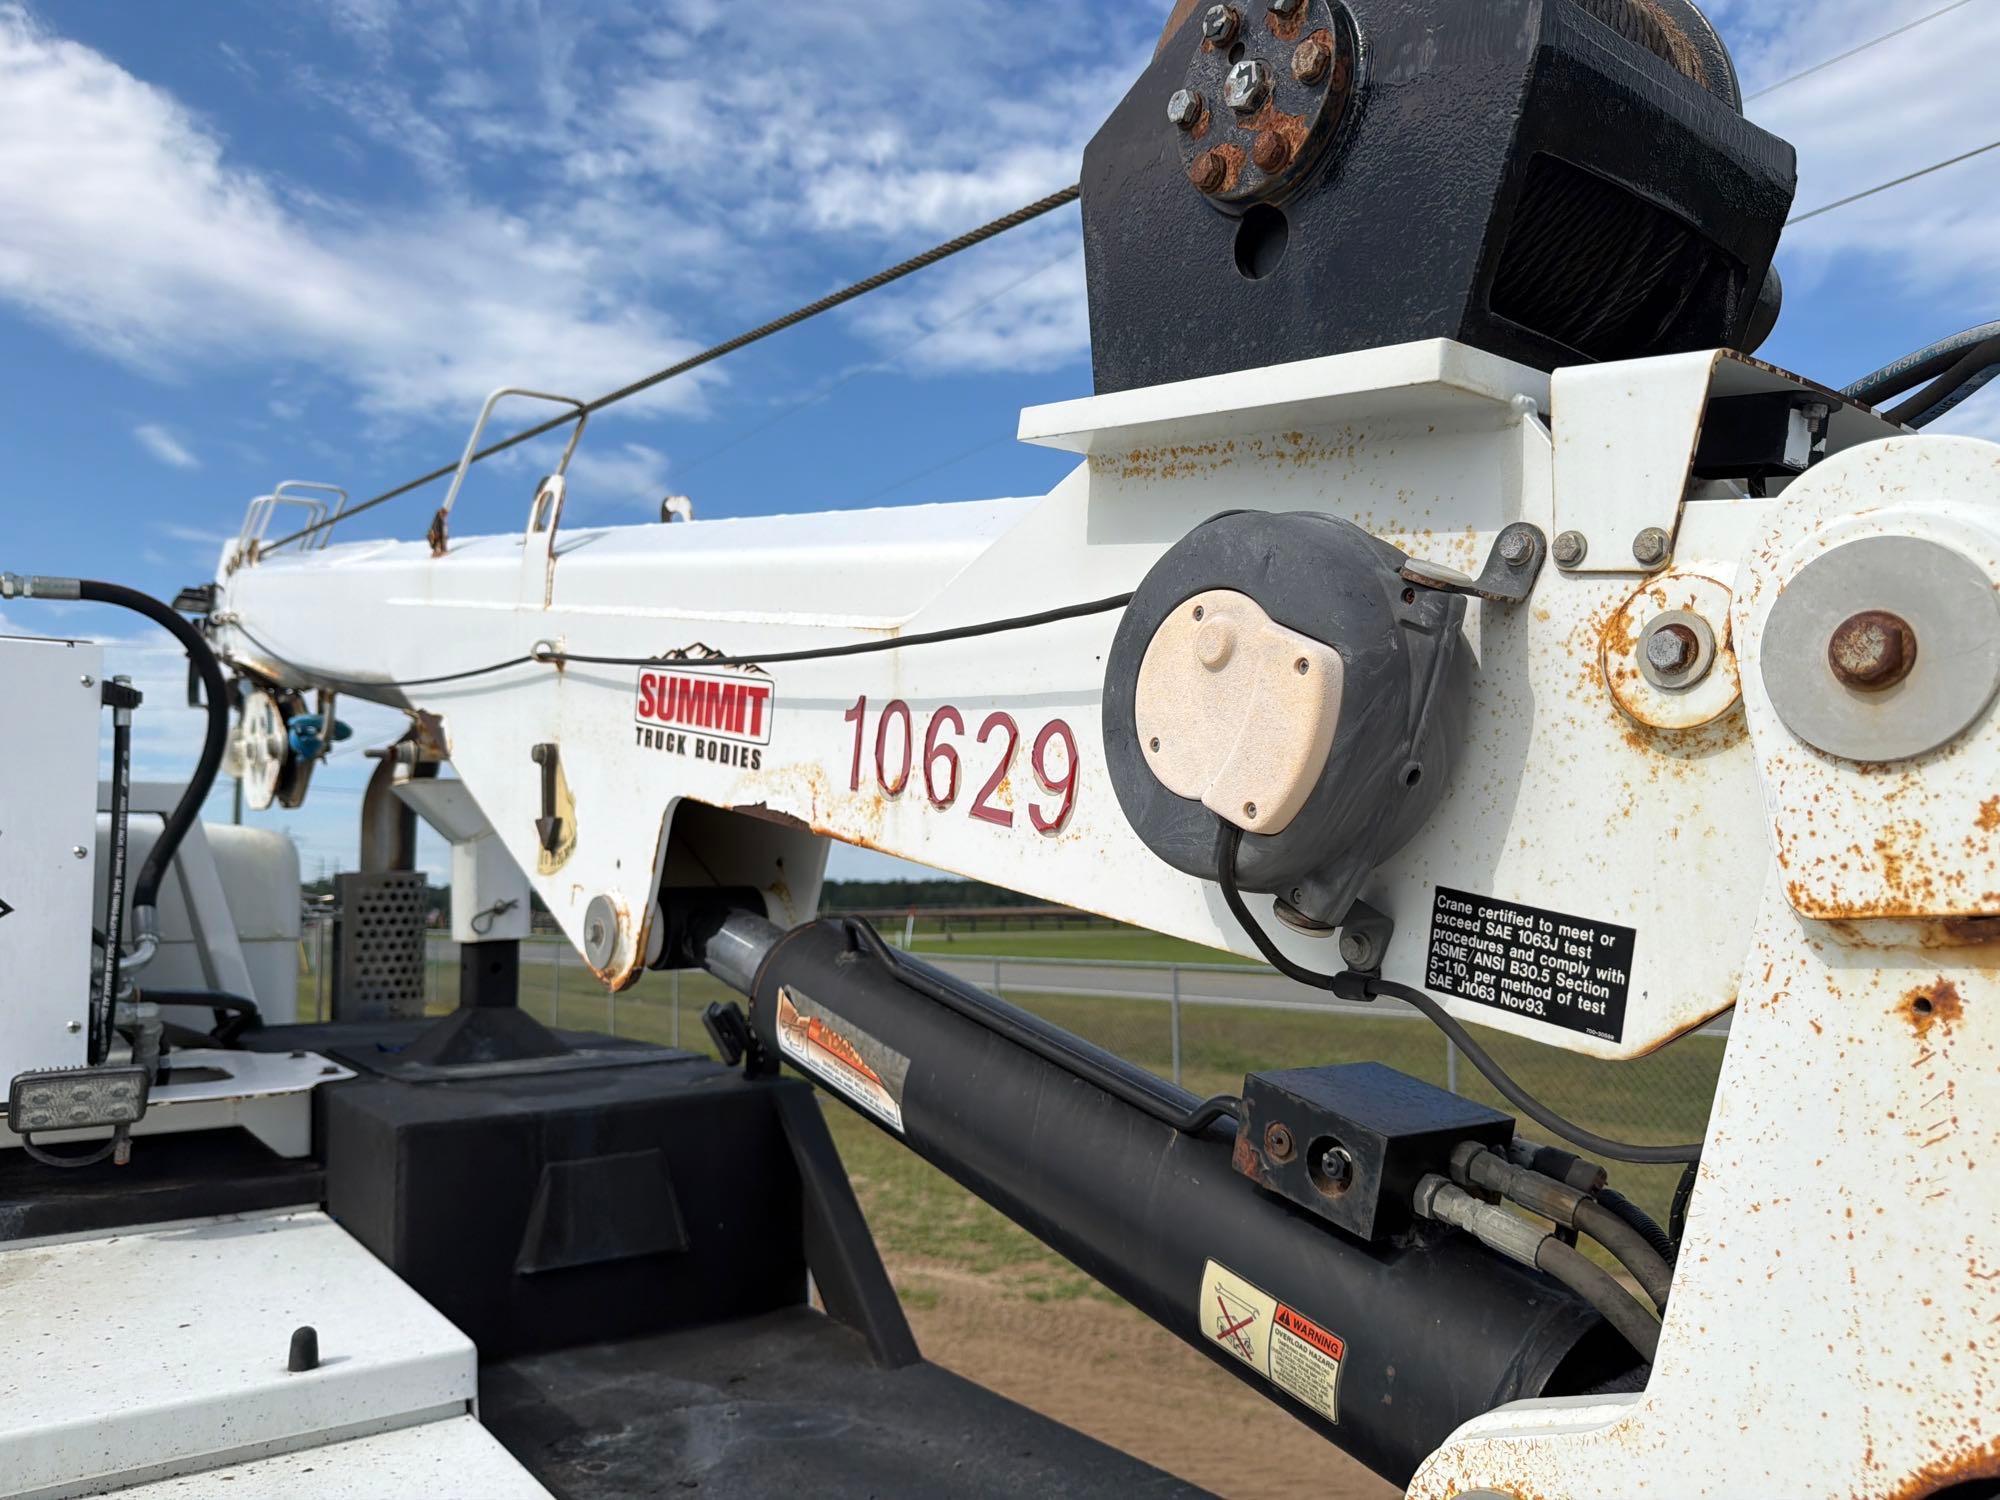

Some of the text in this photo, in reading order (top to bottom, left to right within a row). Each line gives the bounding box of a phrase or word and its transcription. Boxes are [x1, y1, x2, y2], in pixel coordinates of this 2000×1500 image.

[638, 673, 769, 737] SUMMIT
[636, 727, 762, 771] TRUCK BODIES
[845, 695, 1080, 835] 10629
[1435, 913, 1592, 959] exceed SAE 1063J test
[1437, 895, 1616, 947] Crane certified to meet or
[1431, 941, 1610, 999] ASME/ANSI B30.5 Section
[1433, 928, 1625, 985] procedures and comply with
[1428, 971, 1546, 1016] SAE J1063 Nov93.
[1430, 956, 1606, 1016] 5-1.10, per method of test
[1275, 1328, 1335, 1371] OVERLOAD HAZARD
[1293, 1318, 1338, 1354] WARNING
